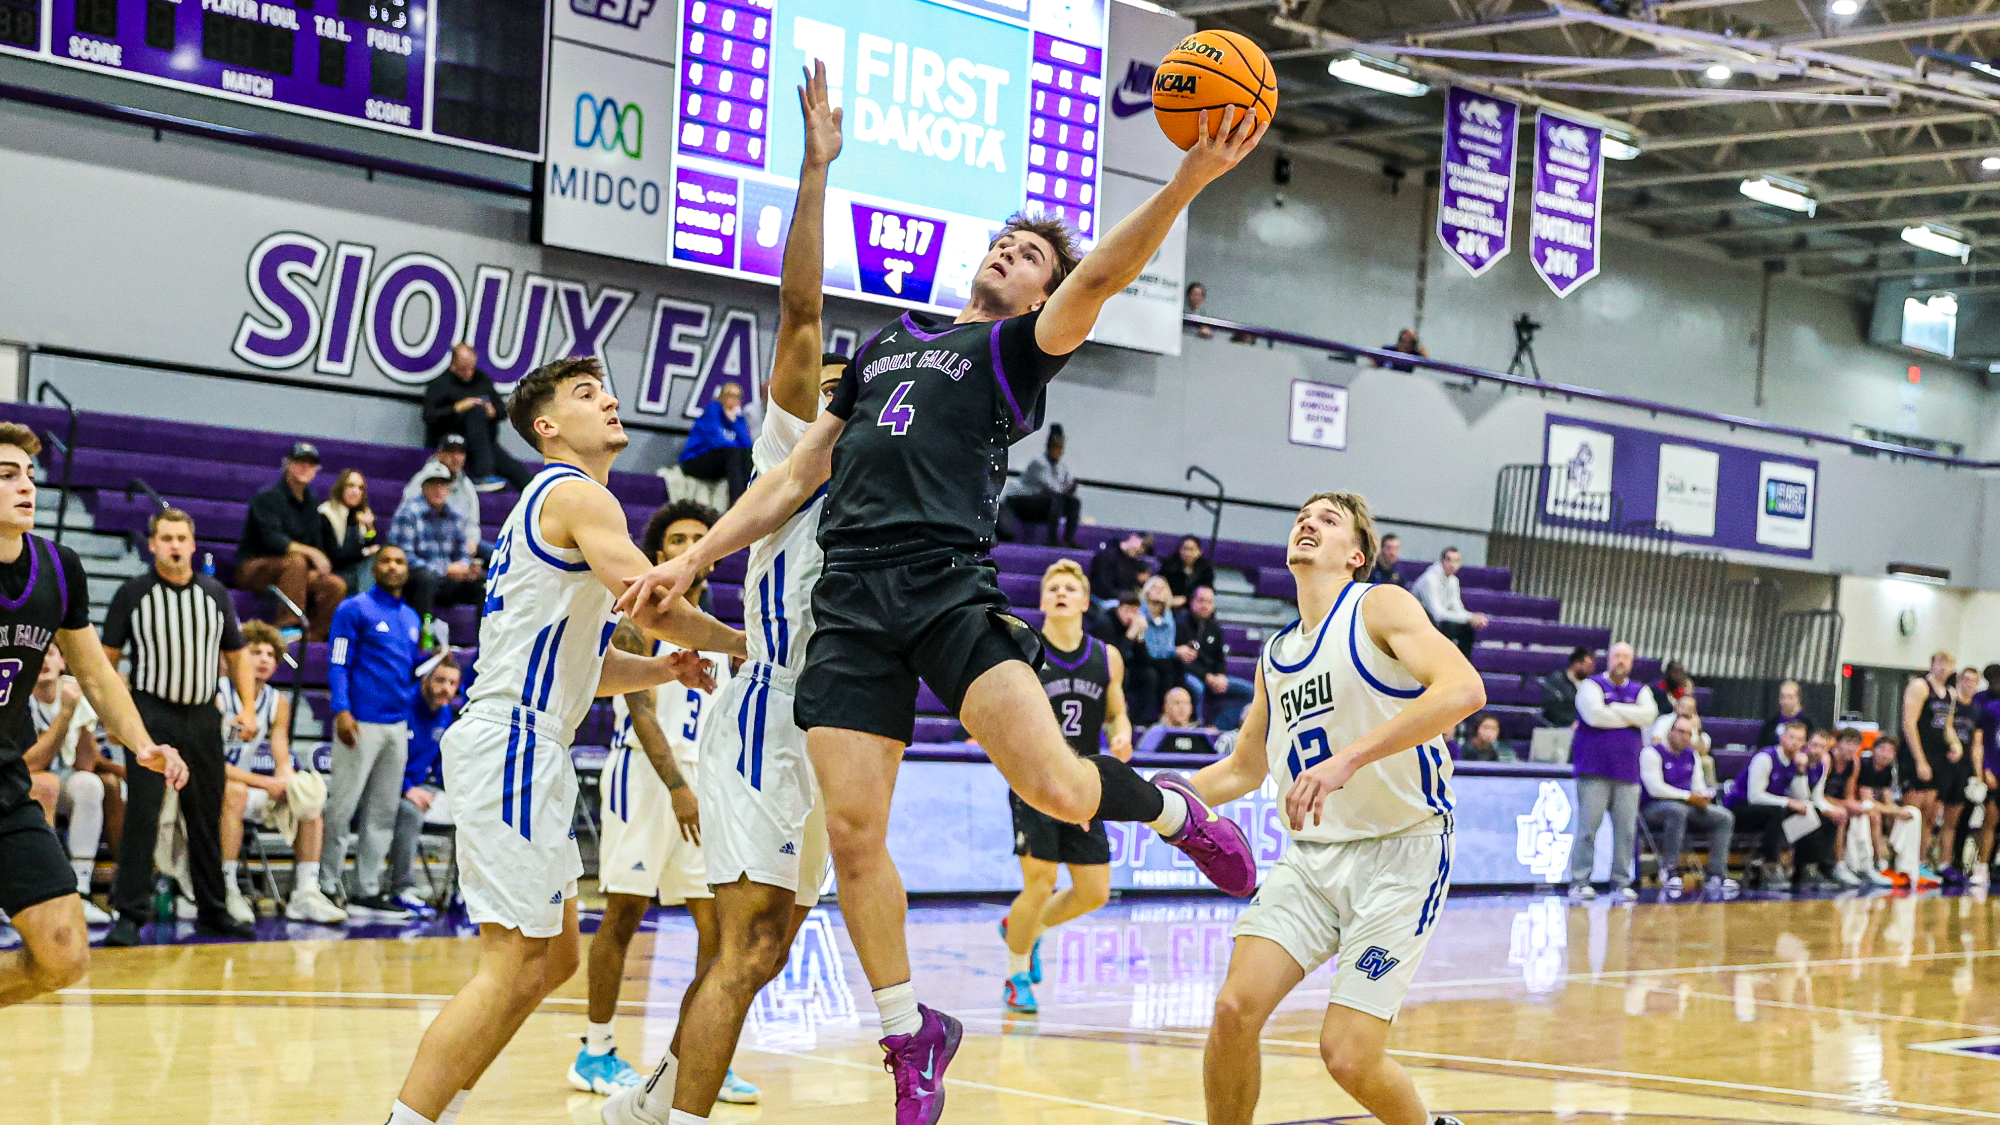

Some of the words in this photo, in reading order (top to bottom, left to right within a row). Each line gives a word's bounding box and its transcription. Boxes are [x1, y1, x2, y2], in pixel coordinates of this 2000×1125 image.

[69, 35, 122, 66] SCORE
[367, 28, 412, 56] FOULS
[222, 69, 274, 99] MATCH
[856, 32, 1010, 126] FIRST
[1154, 74, 1197, 94] NCAA
[365, 99, 412, 126] SCORE
[854, 97, 1006, 173] DAKOTA
[551, 164, 660, 215] MIDCO
[1443, 206, 1504, 238] BASKETBALL
[1533, 212, 1593, 250] FOOTBALL
[233, 232, 638, 393] SIOUX
[863, 351, 917, 383] SIOUX
[916, 350, 972, 381] FALLS
[877, 380, 915, 436] 4
[683, 689, 701, 741] 3
[1281, 671, 1333, 723] GVSU
[1061, 700, 1083, 736] 2
[1355, 945, 1399, 981] GV
